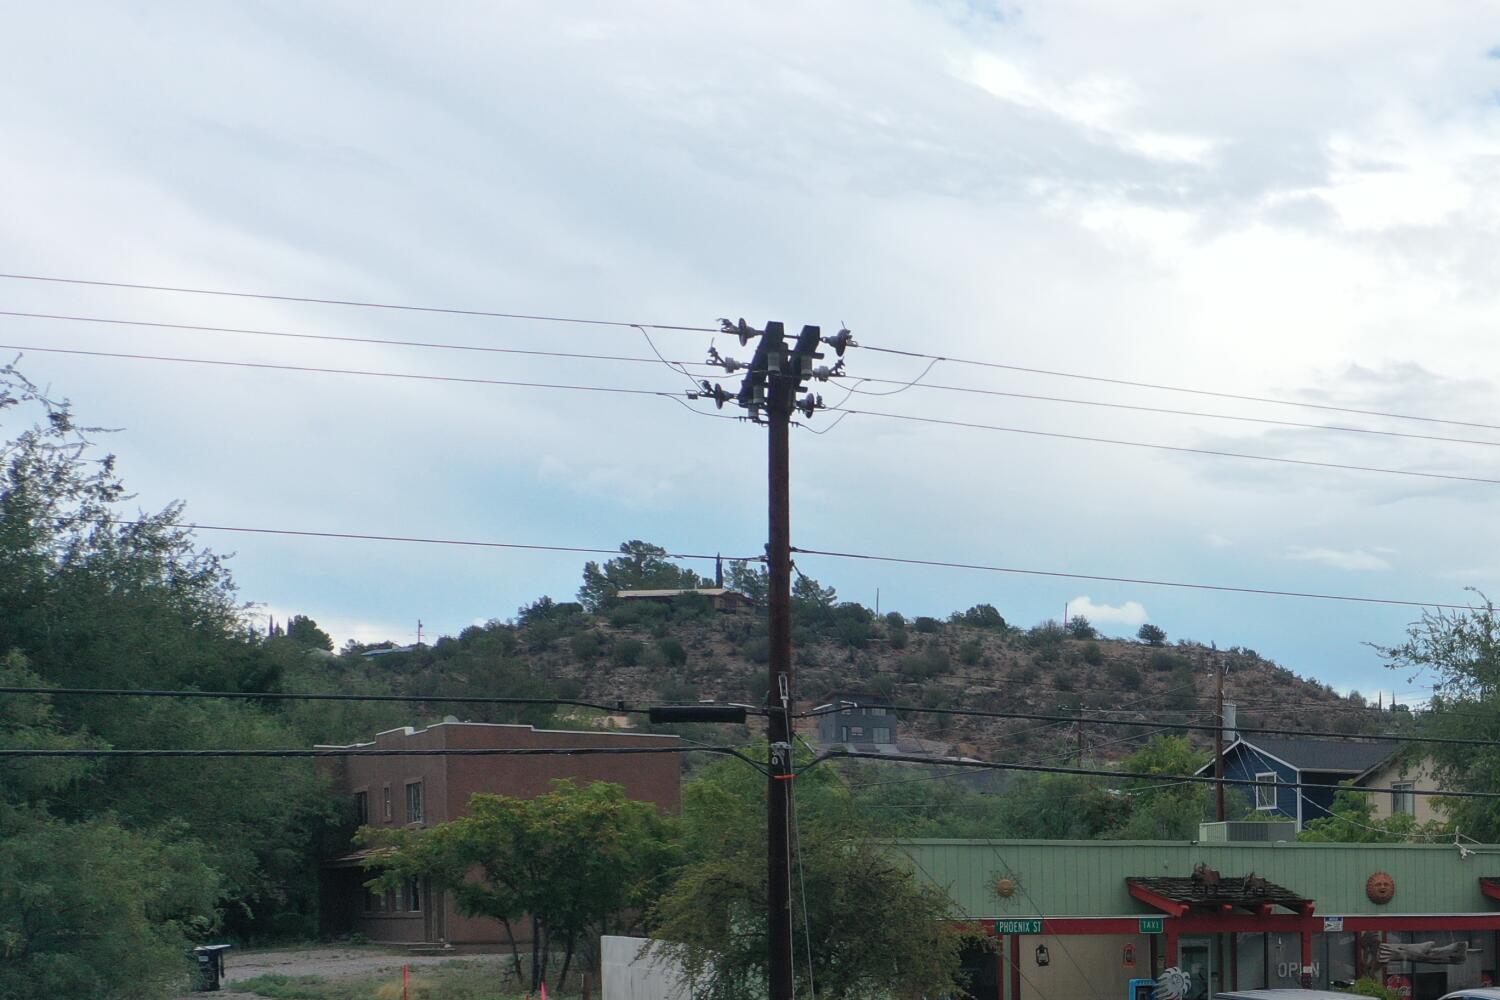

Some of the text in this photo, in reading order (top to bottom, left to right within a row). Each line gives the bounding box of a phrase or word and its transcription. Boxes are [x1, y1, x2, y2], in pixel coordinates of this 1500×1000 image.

[999, 921, 1041, 933] PHOENIX ST
[1142, 921, 1159, 929] TAXI
[1278, 962, 1320, 978] OPN
